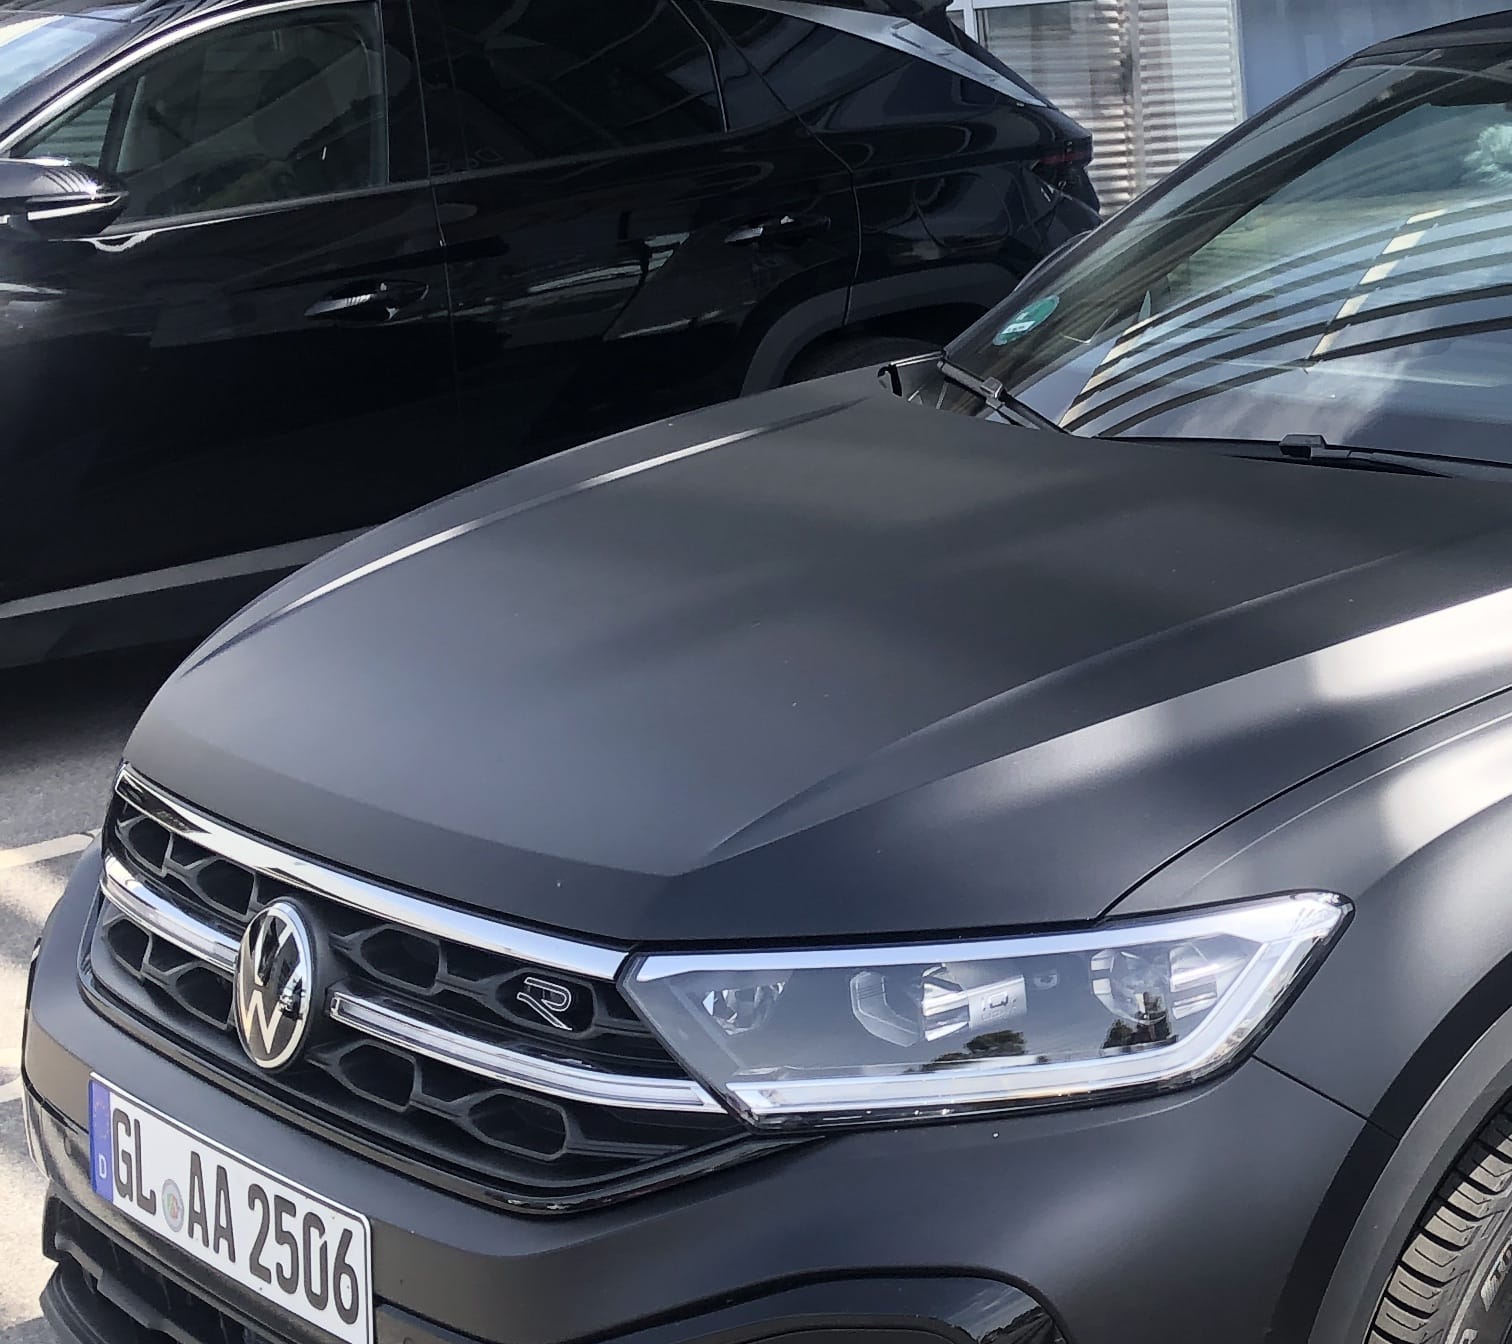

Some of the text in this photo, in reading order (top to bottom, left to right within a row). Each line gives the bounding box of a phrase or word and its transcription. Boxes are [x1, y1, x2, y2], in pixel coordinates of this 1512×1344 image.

[515, 976, 574, 1031] R
[98, 1153, 107, 1179] D
[112, 1107, 360, 1325] GL AA 2506
